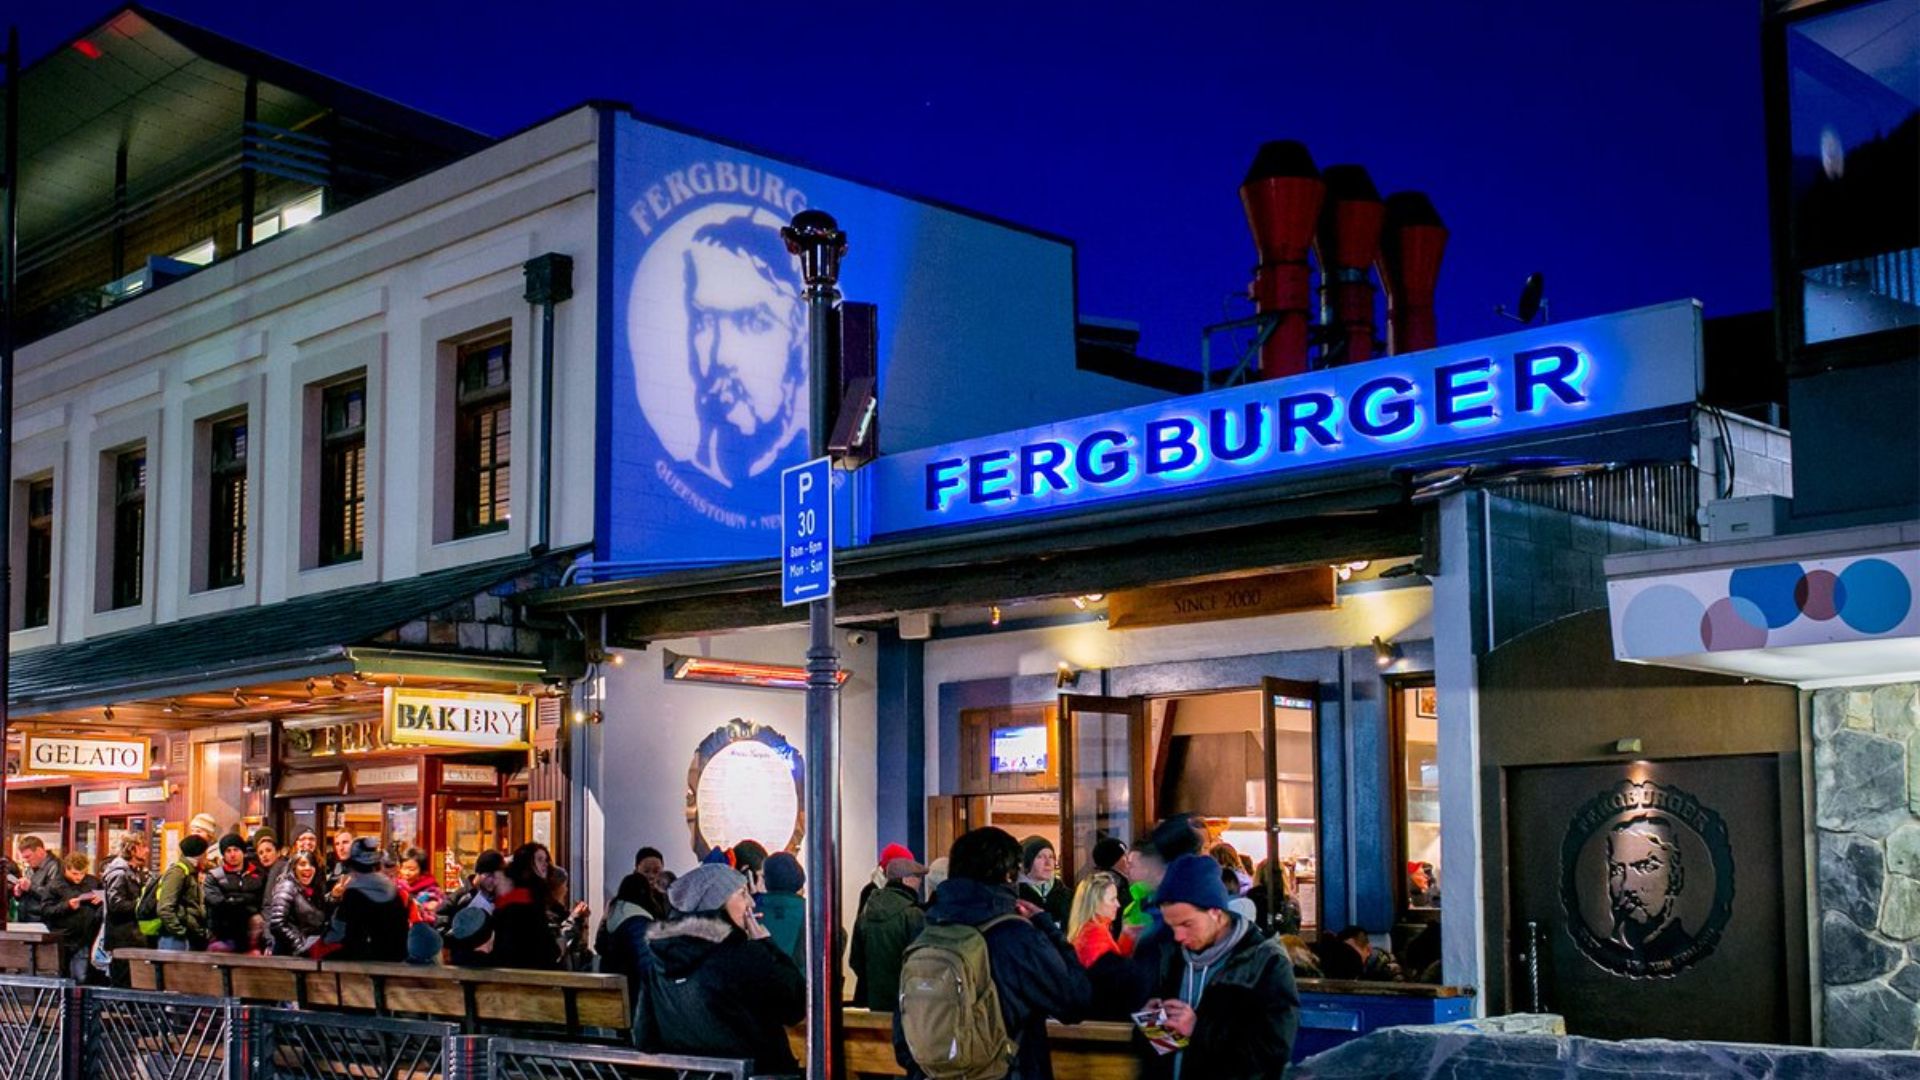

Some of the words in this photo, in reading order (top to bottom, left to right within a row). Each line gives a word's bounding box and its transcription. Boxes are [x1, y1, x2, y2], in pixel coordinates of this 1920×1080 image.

[629, 161, 808, 237] FERGBURG
[925, 344, 1588, 512] FERGBURGER
[655, 460, 748, 529] QUEENSTOWN
[798, 471, 813, 505] P
[797, 508, 815, 538] 30
[789, 564, 804, 578] Mon
[810, 560, 824, 574] Sun
[1173, 593, 1217, 614] SINCE
[1223, 588, 1261, 609] 2000
[397, 703, 521, 736] BAKERY
[35, 743, 139, 768] GELATO
